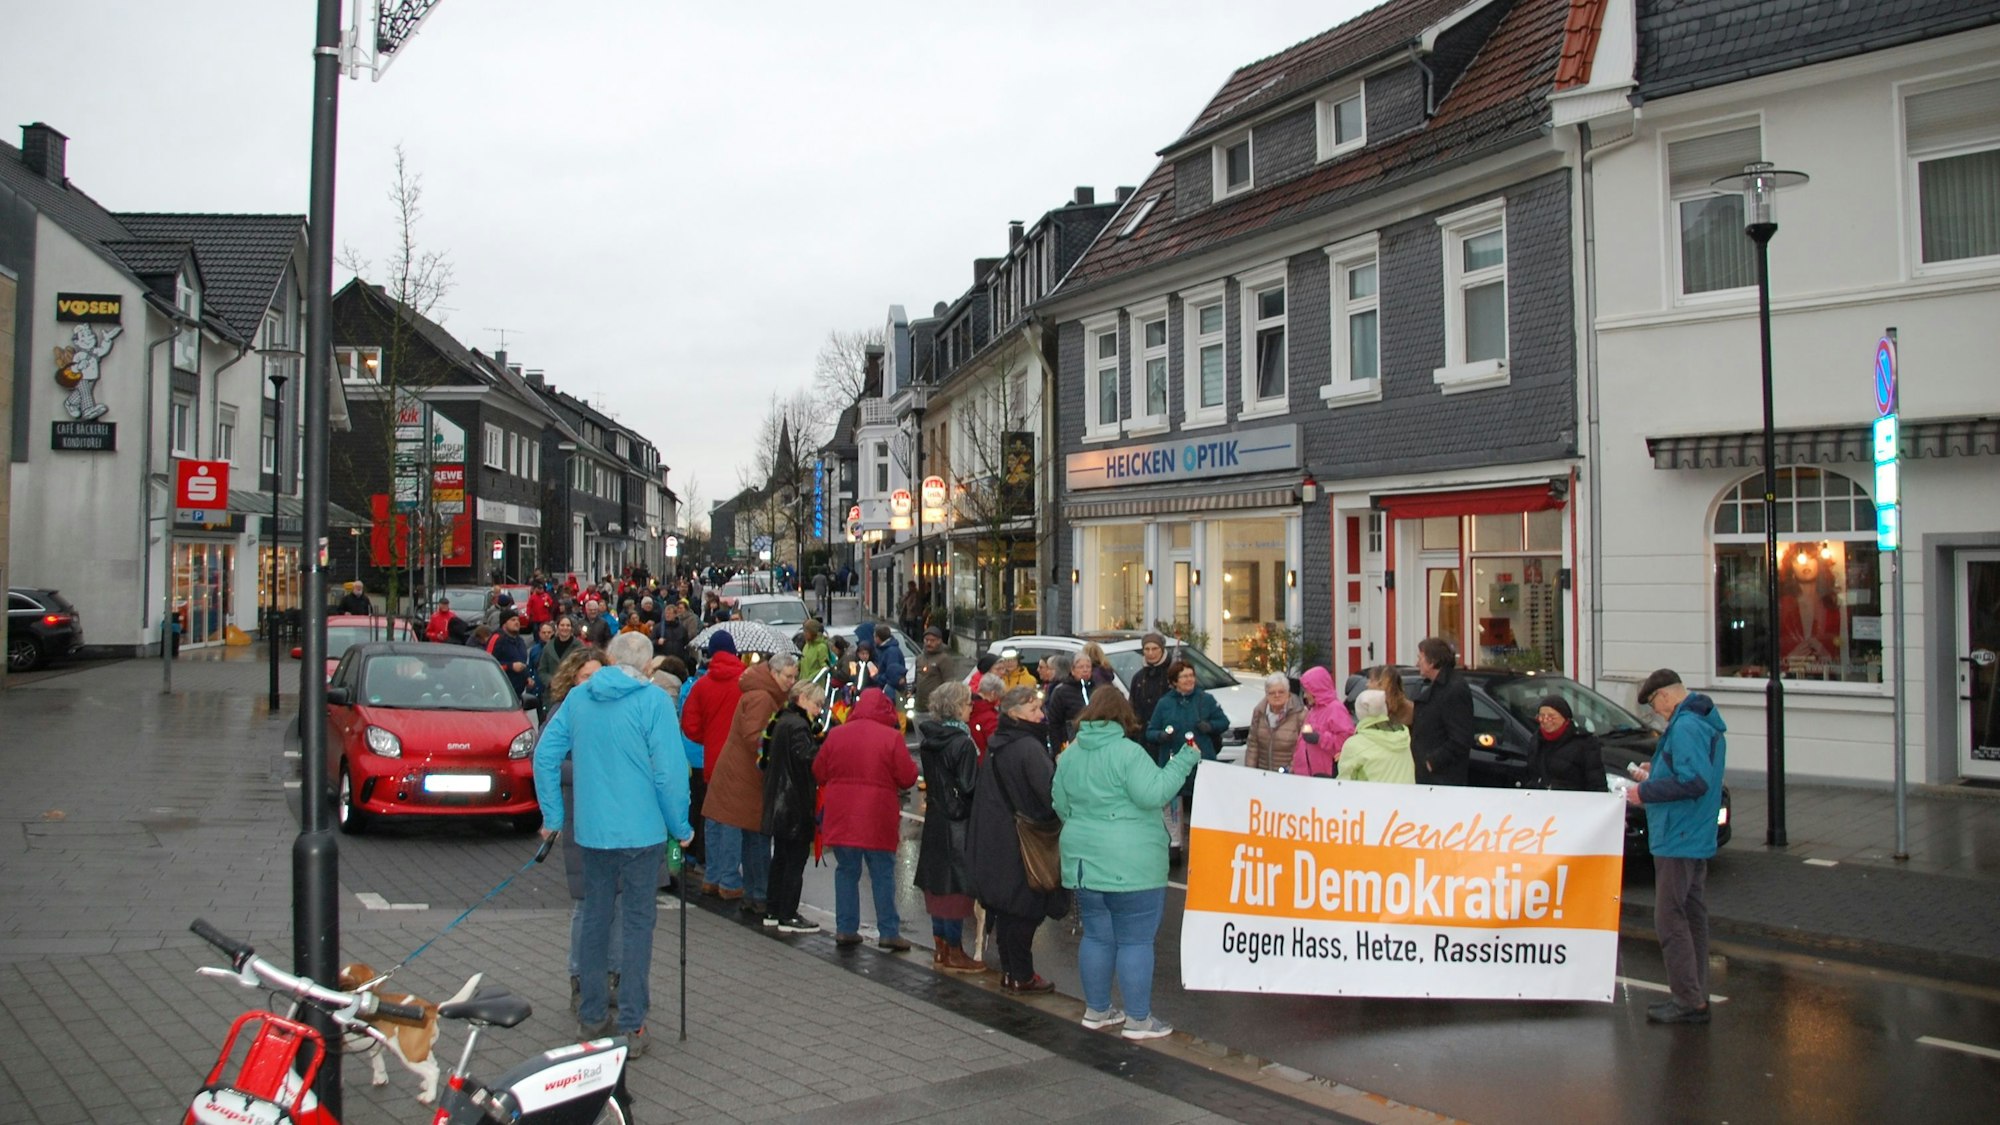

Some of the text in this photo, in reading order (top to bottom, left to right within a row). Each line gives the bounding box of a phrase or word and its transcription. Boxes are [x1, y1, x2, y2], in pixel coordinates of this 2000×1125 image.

[434, 470, 464, 480] REWE
[1106, 440, 1240, 479] HEICKEN OPTIK
[447, 742, 471, 750] smart
[1250, 799, 1558, 854] Burscheid leuchtet
[1229, 843, 1569, 921] für Demokratie!
[1222, 921, 1567, 965] Gegen Hass, Hetze, Rassismus
